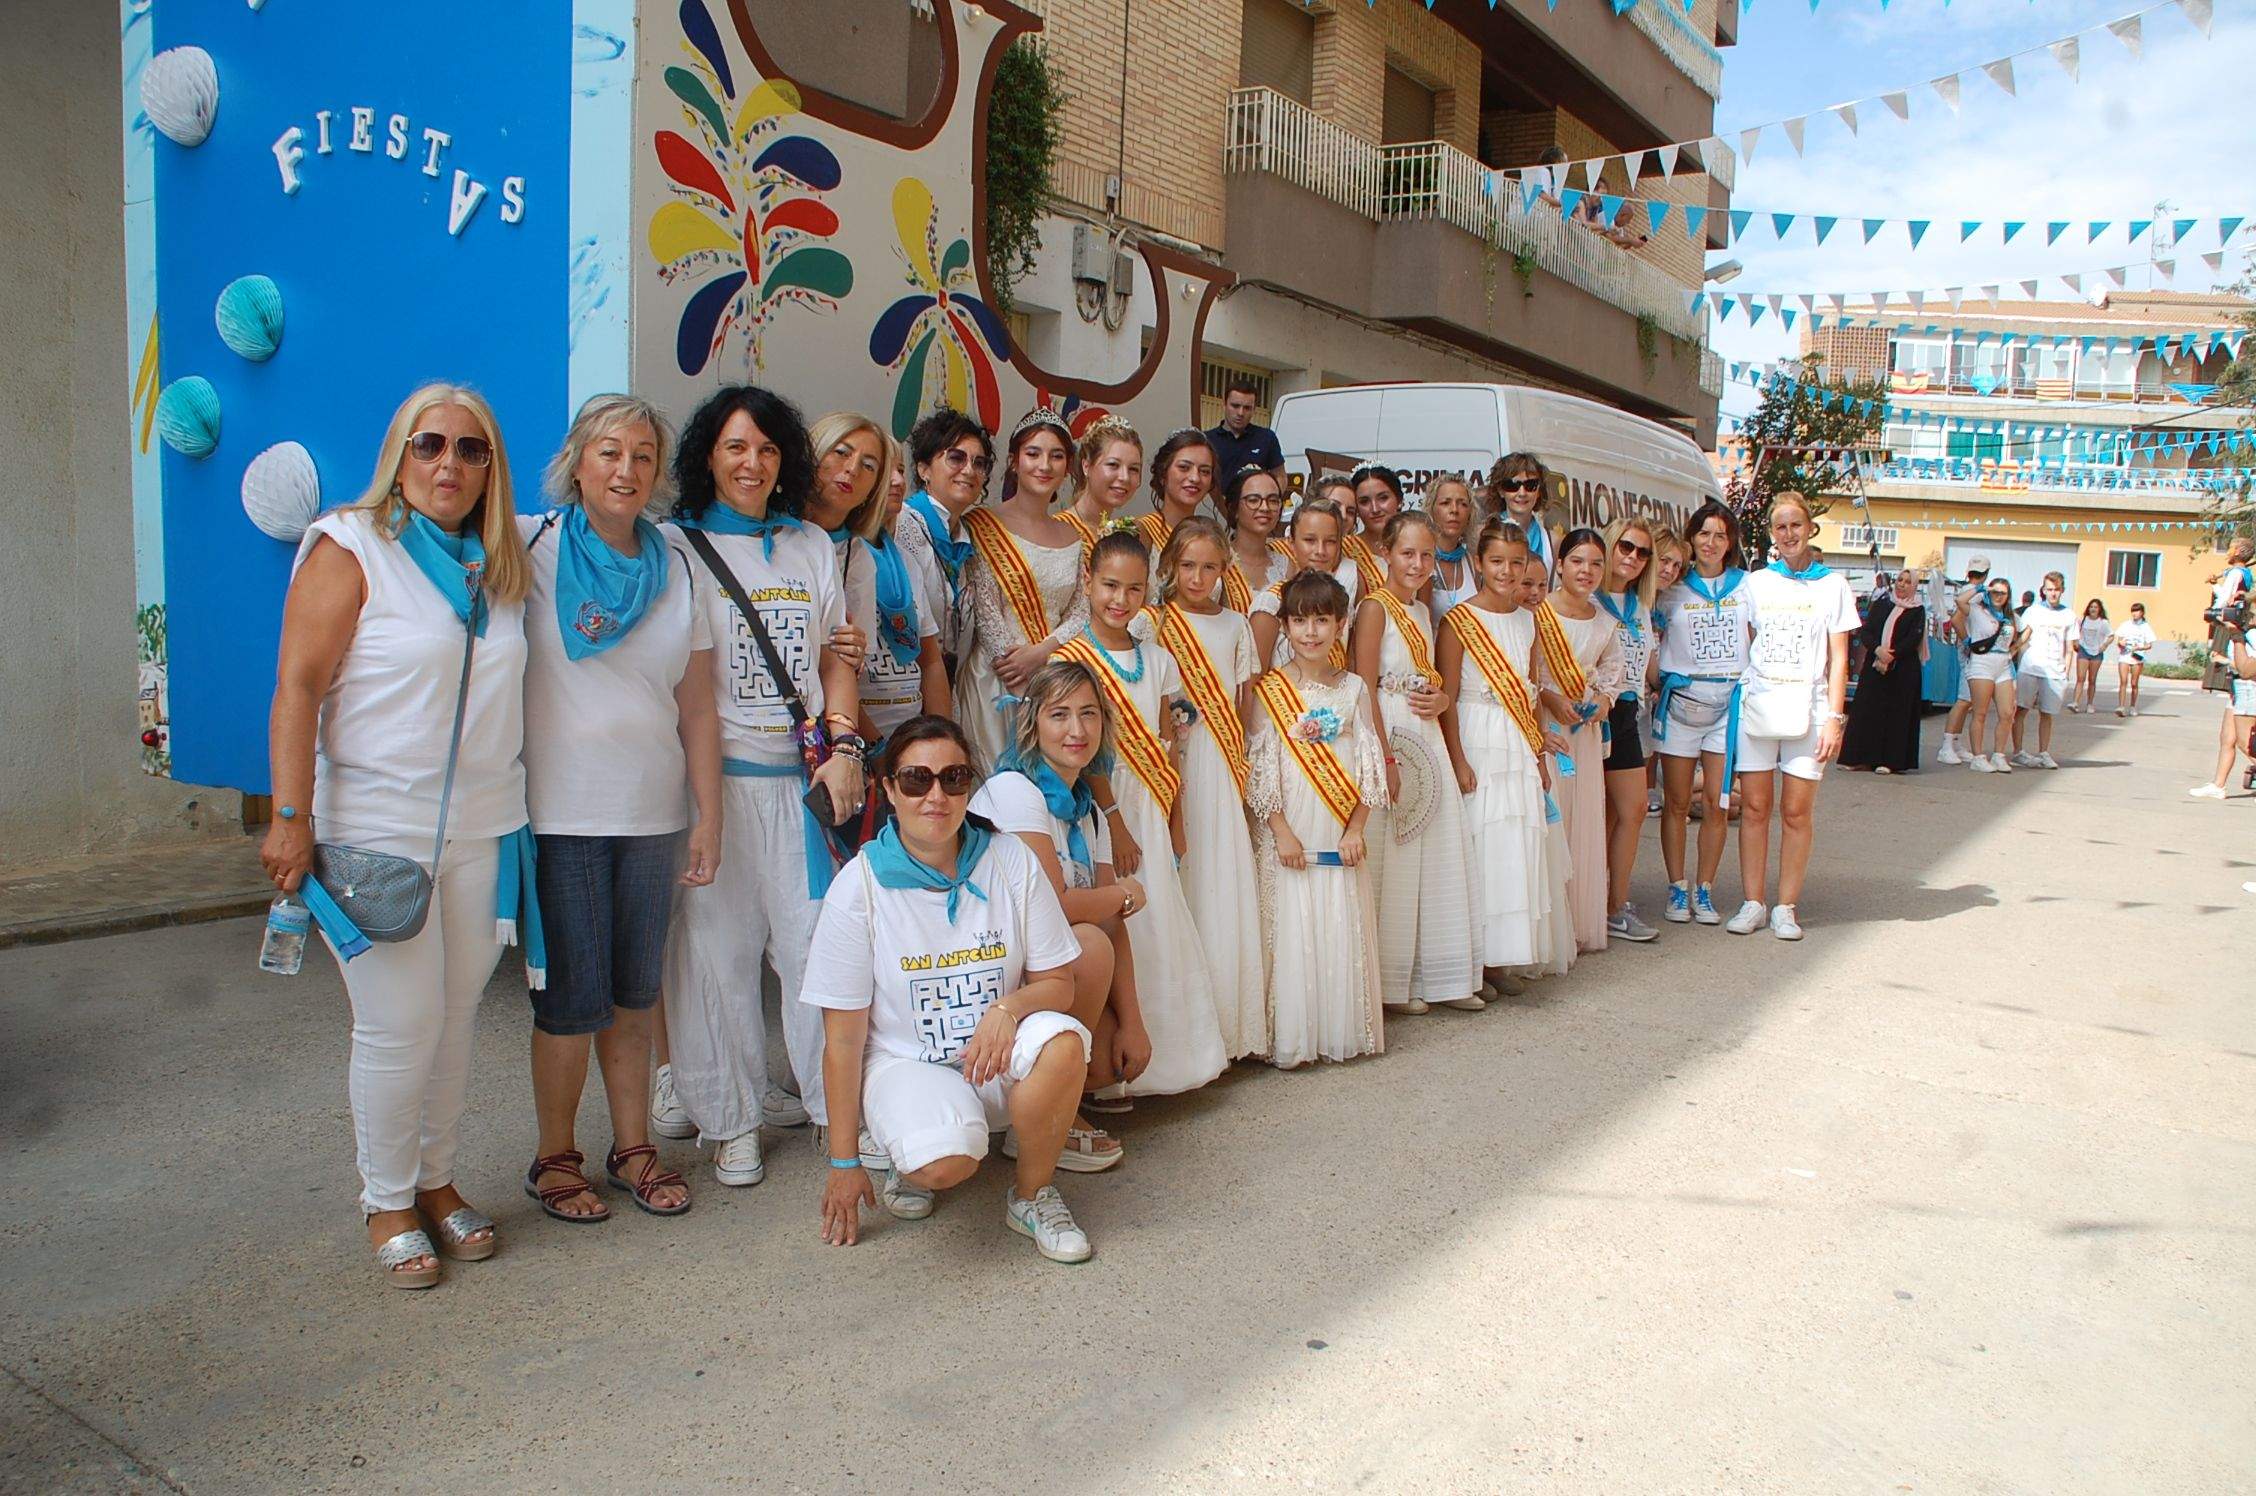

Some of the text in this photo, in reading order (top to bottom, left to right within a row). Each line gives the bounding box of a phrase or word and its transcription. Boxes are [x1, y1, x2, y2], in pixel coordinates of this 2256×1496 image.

[272, 106, 526, 236] FIESTAS
[900, 942, 1006, 971] SAN ANTOLIN
